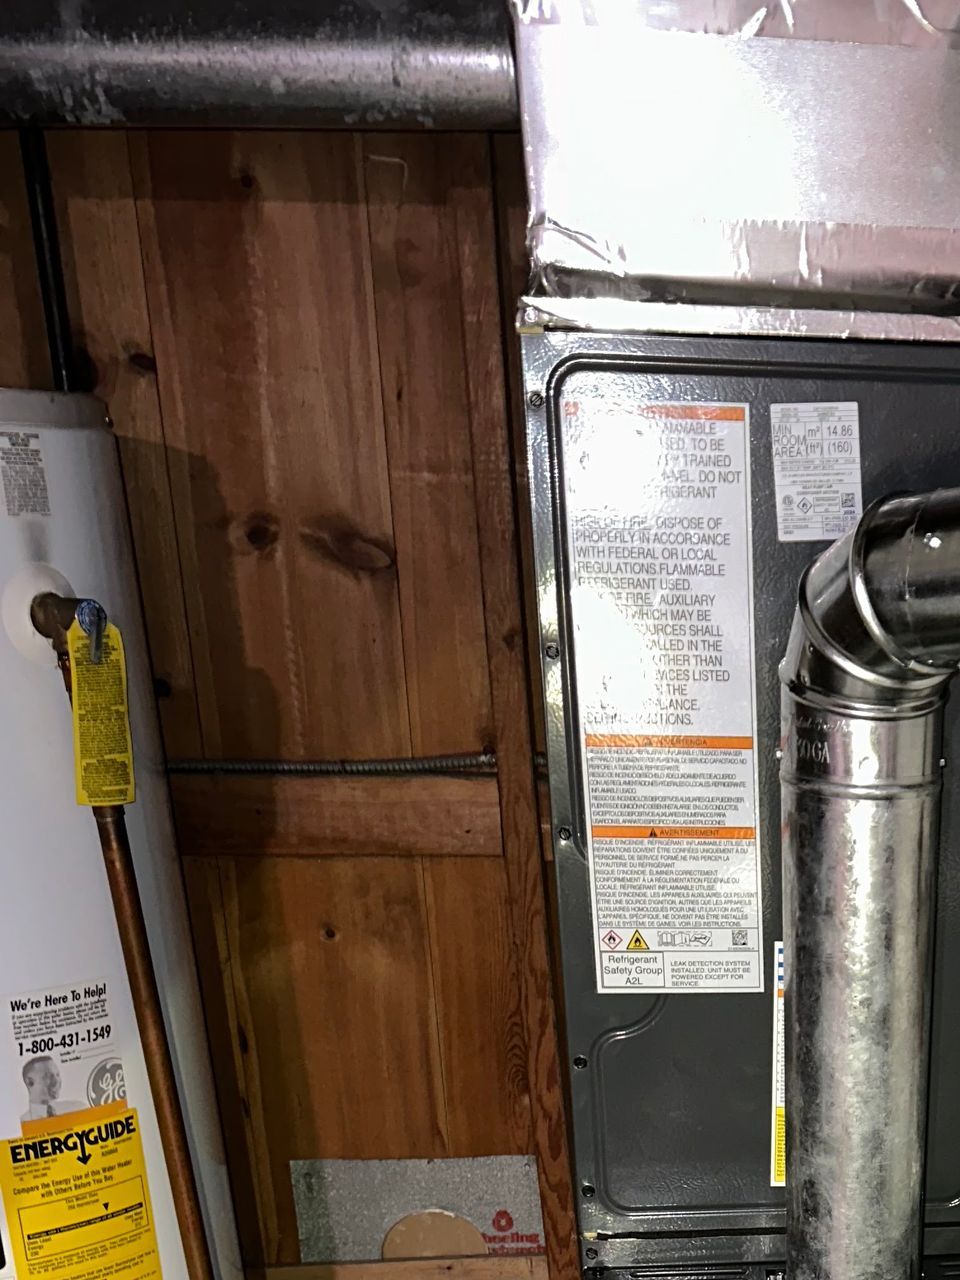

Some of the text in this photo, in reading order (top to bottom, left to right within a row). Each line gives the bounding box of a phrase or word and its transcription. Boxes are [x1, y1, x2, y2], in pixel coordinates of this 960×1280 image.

[772, 424, 792, 435] MIN
[827, 424, 853, 437] 14.86
[690, 438, 726, 451] TO BE
[773, 434, 806, 447] ROOM
[774, 446, 803, 458] AREA
[827, 440, 853, 456] (160)
[682, 453, 732, 468] TRAINED
[698, 469, 716, 483] DO
[718, 470, 742, 484] NOT
[655, 516, 704, 530] DISPOSE
[707, 517, 723, 530] OF
[575, 528, 731, 546] PROPERLY IN ACCORDANCE
[576, 545, 718, 561] WITH FEDERAL OR LOCAL
[659, 563, 726, 577] FLAMMABLE
[660, 578, 693, 591] USED.
[659, 593, 716, 607] AUXILIARY
[670, 609, 695, 622] MAY
[697, 609, 712, 622] BE
[688, 624, 723, 637] SHALL
[687, 639, 698, 651] IN
[700, 639, 723, 652] THE
[692, 654, 723, 667] THAN
[692, 669, 731, 682] LISTED
[666, 683, 688, 696] THE
[659, 828, 720, 837] AVERTISSEMENT
[608, 955, 658, 966] Refrigerant
[604, 965, 663, 977] Safety Group
[625, 976, 644, 985] A2L
[10, 983, 107, 1012] We're Here To Help!
[18, 1024, 112, 1056] 1-800-431-1549
[10, 1115, 137, 1165] ENERGYGUIDE
[13, 1184, 40, 1196] Compare
[41, 1182, 51, 1190] the
[52, 1177, 71, 1188] Energy
[72, 1174, 83, 1183] Use
[91, 1169, 101, 1178] this
[101, 1164, 117, 1175] Water
[117, 1159, 133, 1171] Heater
[55, 1186, 73, 1197] Others
[74, 1181, 91, 1191] Before
[93, 1178, 102, 1186] You
